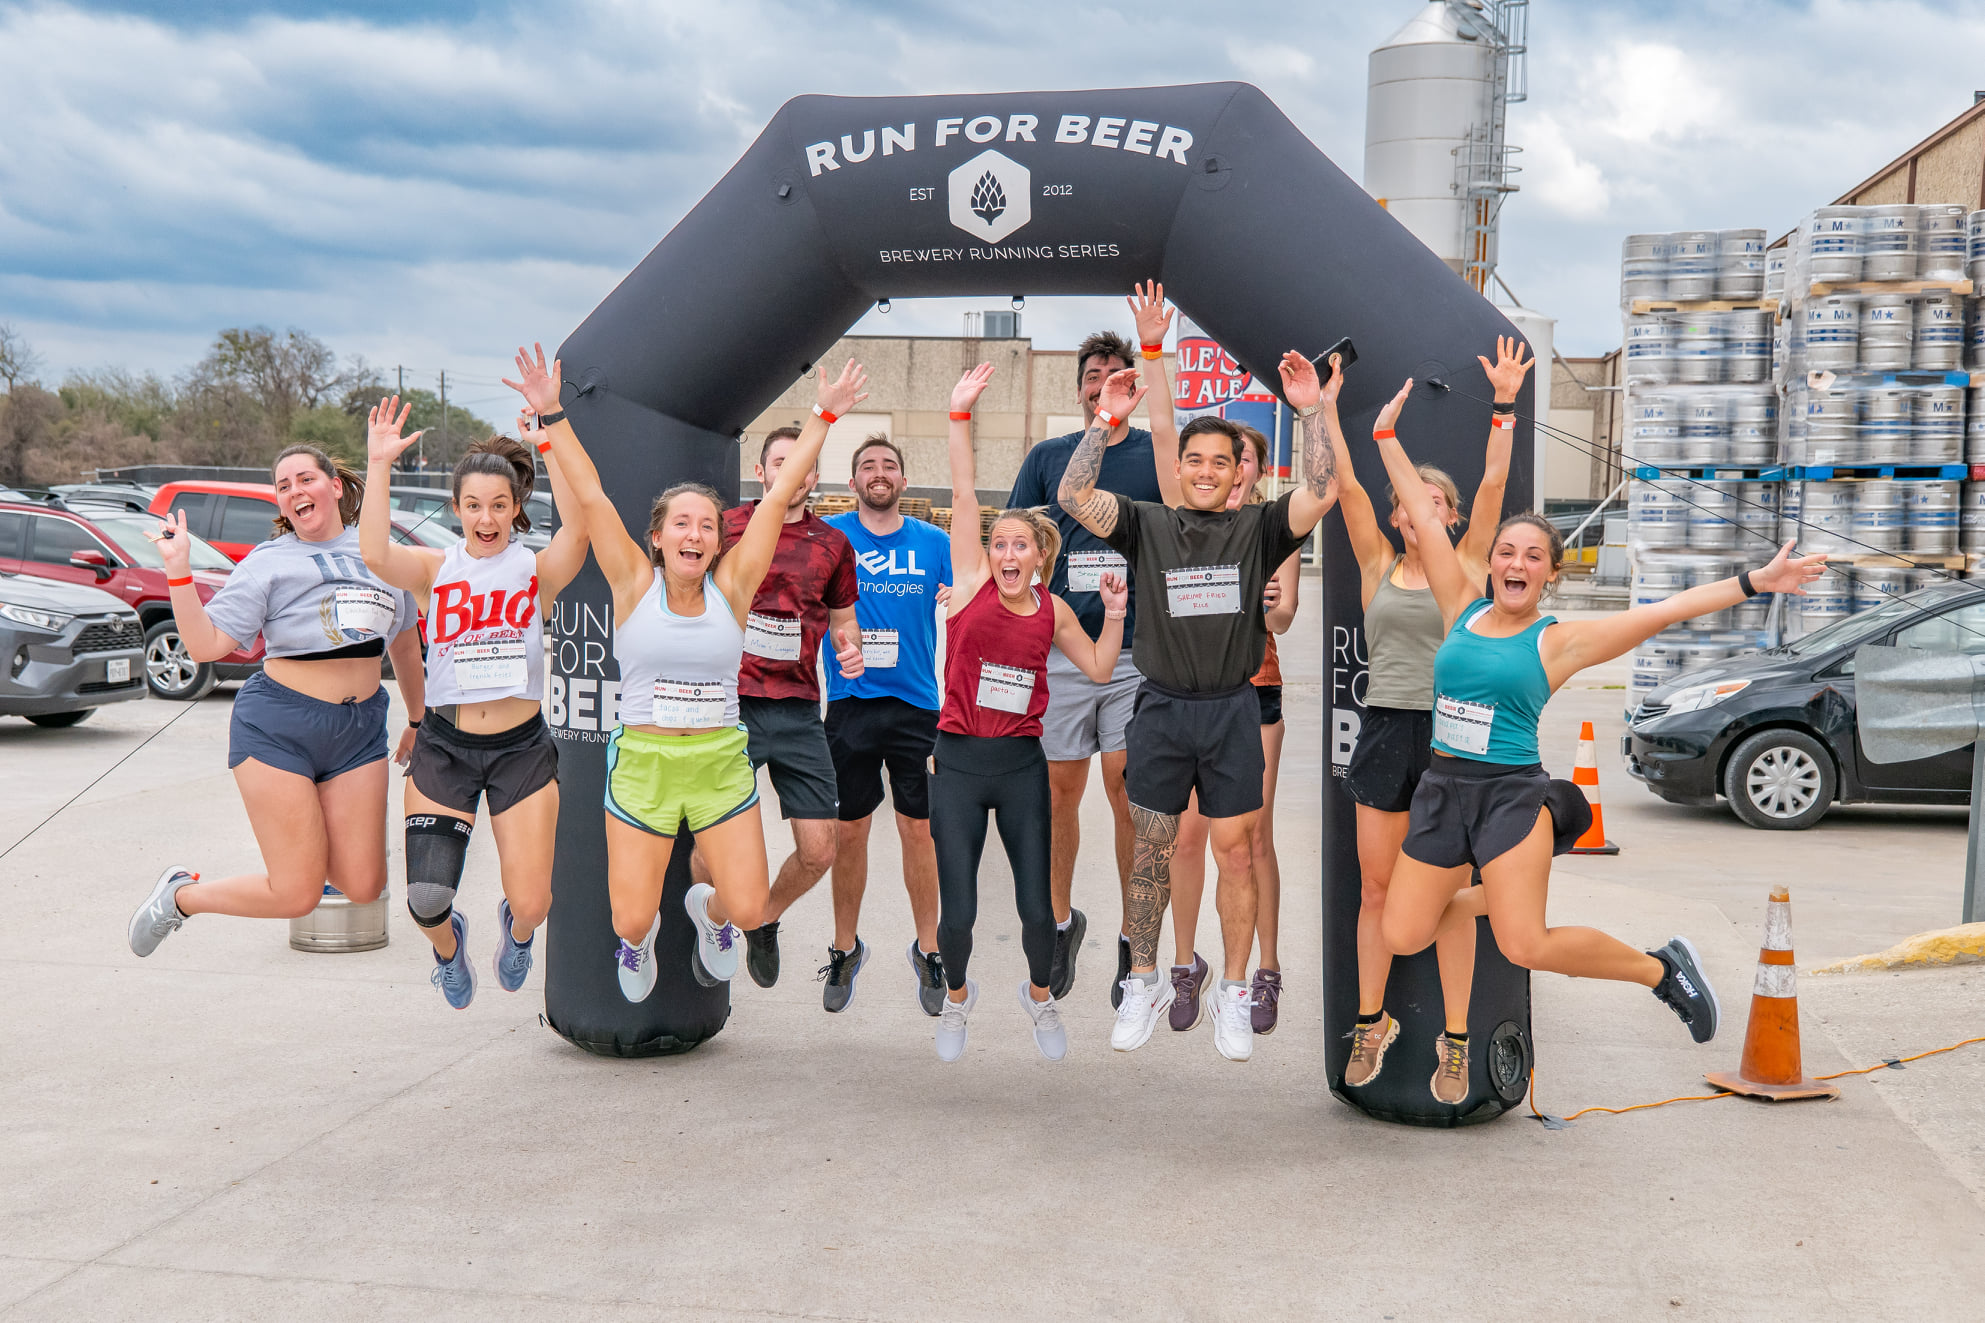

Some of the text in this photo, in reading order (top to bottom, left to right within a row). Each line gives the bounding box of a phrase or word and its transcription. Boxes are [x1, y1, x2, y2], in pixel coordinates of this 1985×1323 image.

[805, 114, 1195, 177] RUN FOR BEER
[909, 187, 936, 201] EST
[1042, 184, 1073, 197] 2012
[879, 243, 1121, 263] BREWERY RUNNING SERIES
[1195, 379, 1244, 404] ALE
[433, 575, 539, 644] Bud
[551, 637, 606, 677] FOR
[1675, 970, 1700, 999] HOKA
